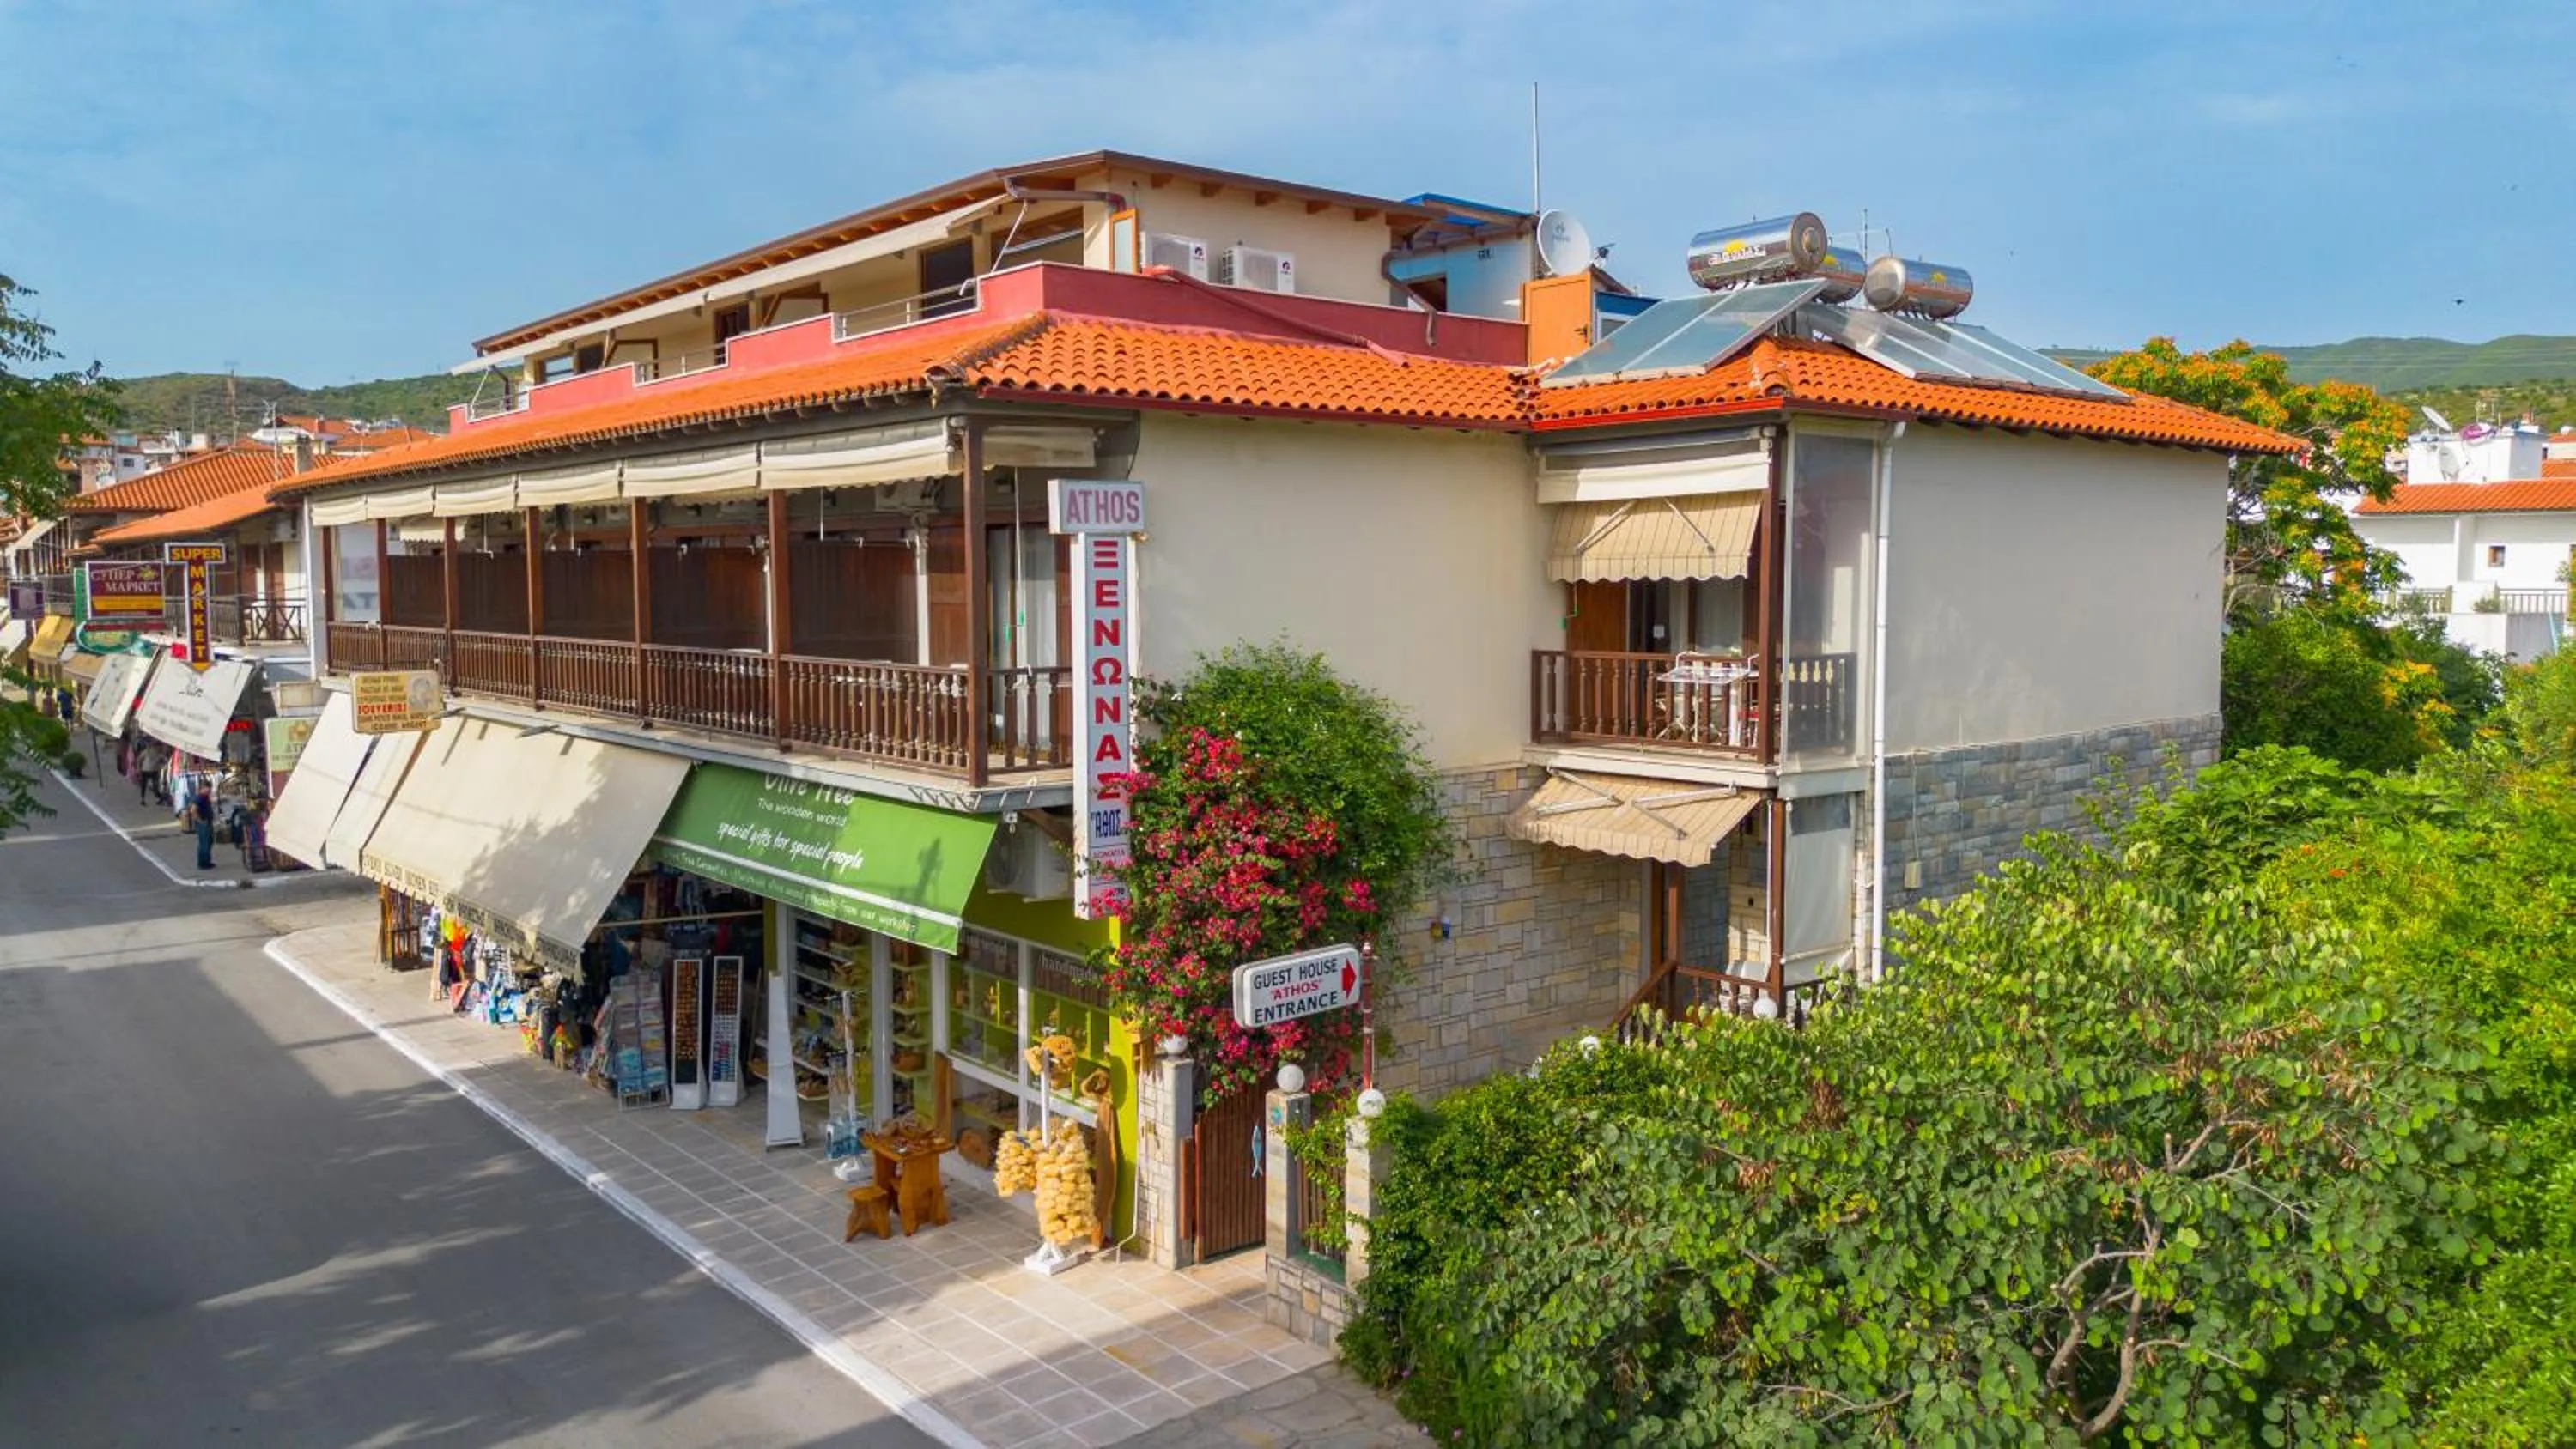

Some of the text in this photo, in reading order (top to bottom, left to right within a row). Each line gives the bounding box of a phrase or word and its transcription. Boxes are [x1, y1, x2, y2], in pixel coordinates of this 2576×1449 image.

[1066, 489, 1140, 524] ATHOS
[171, 548, 221, 559] SUPER
[104, 581, 161, 592] МАРКЕТ
[190, 565, 206, 658] MARKET
[756, 797, 774, 812] The
[775, 803, 814, 820] wooden
[717, 822, 755, 841] special
[773, 830, 790, 850] for
[790, 840, 830, 862] special
[1253, 958, 1338, 990] GUEST HOUSE
[1270, 979, 1323, 1001] "ATHOS"
[1255, 990, 1338, 1024] ENTRANCE
